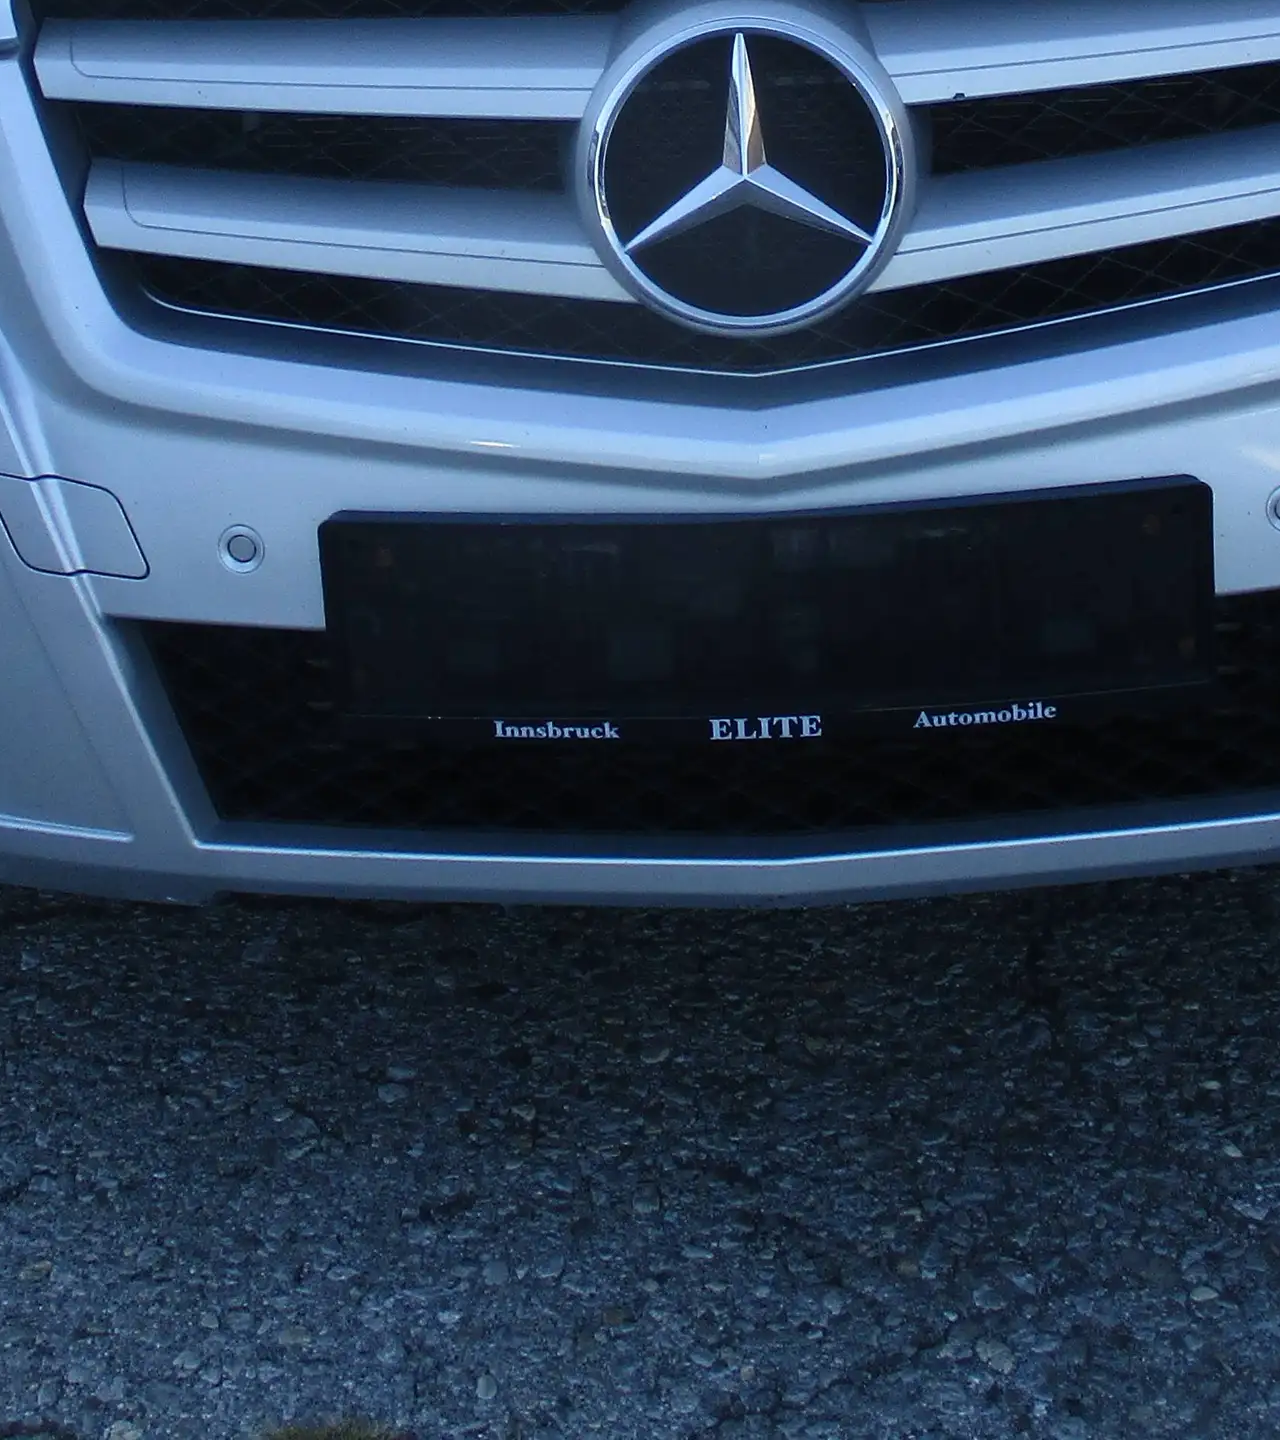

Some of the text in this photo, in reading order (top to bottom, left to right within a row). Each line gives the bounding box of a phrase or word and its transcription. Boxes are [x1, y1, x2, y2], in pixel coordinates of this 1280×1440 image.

[493, 701, 1057, 741] Innsbruck ELITE Automobile
